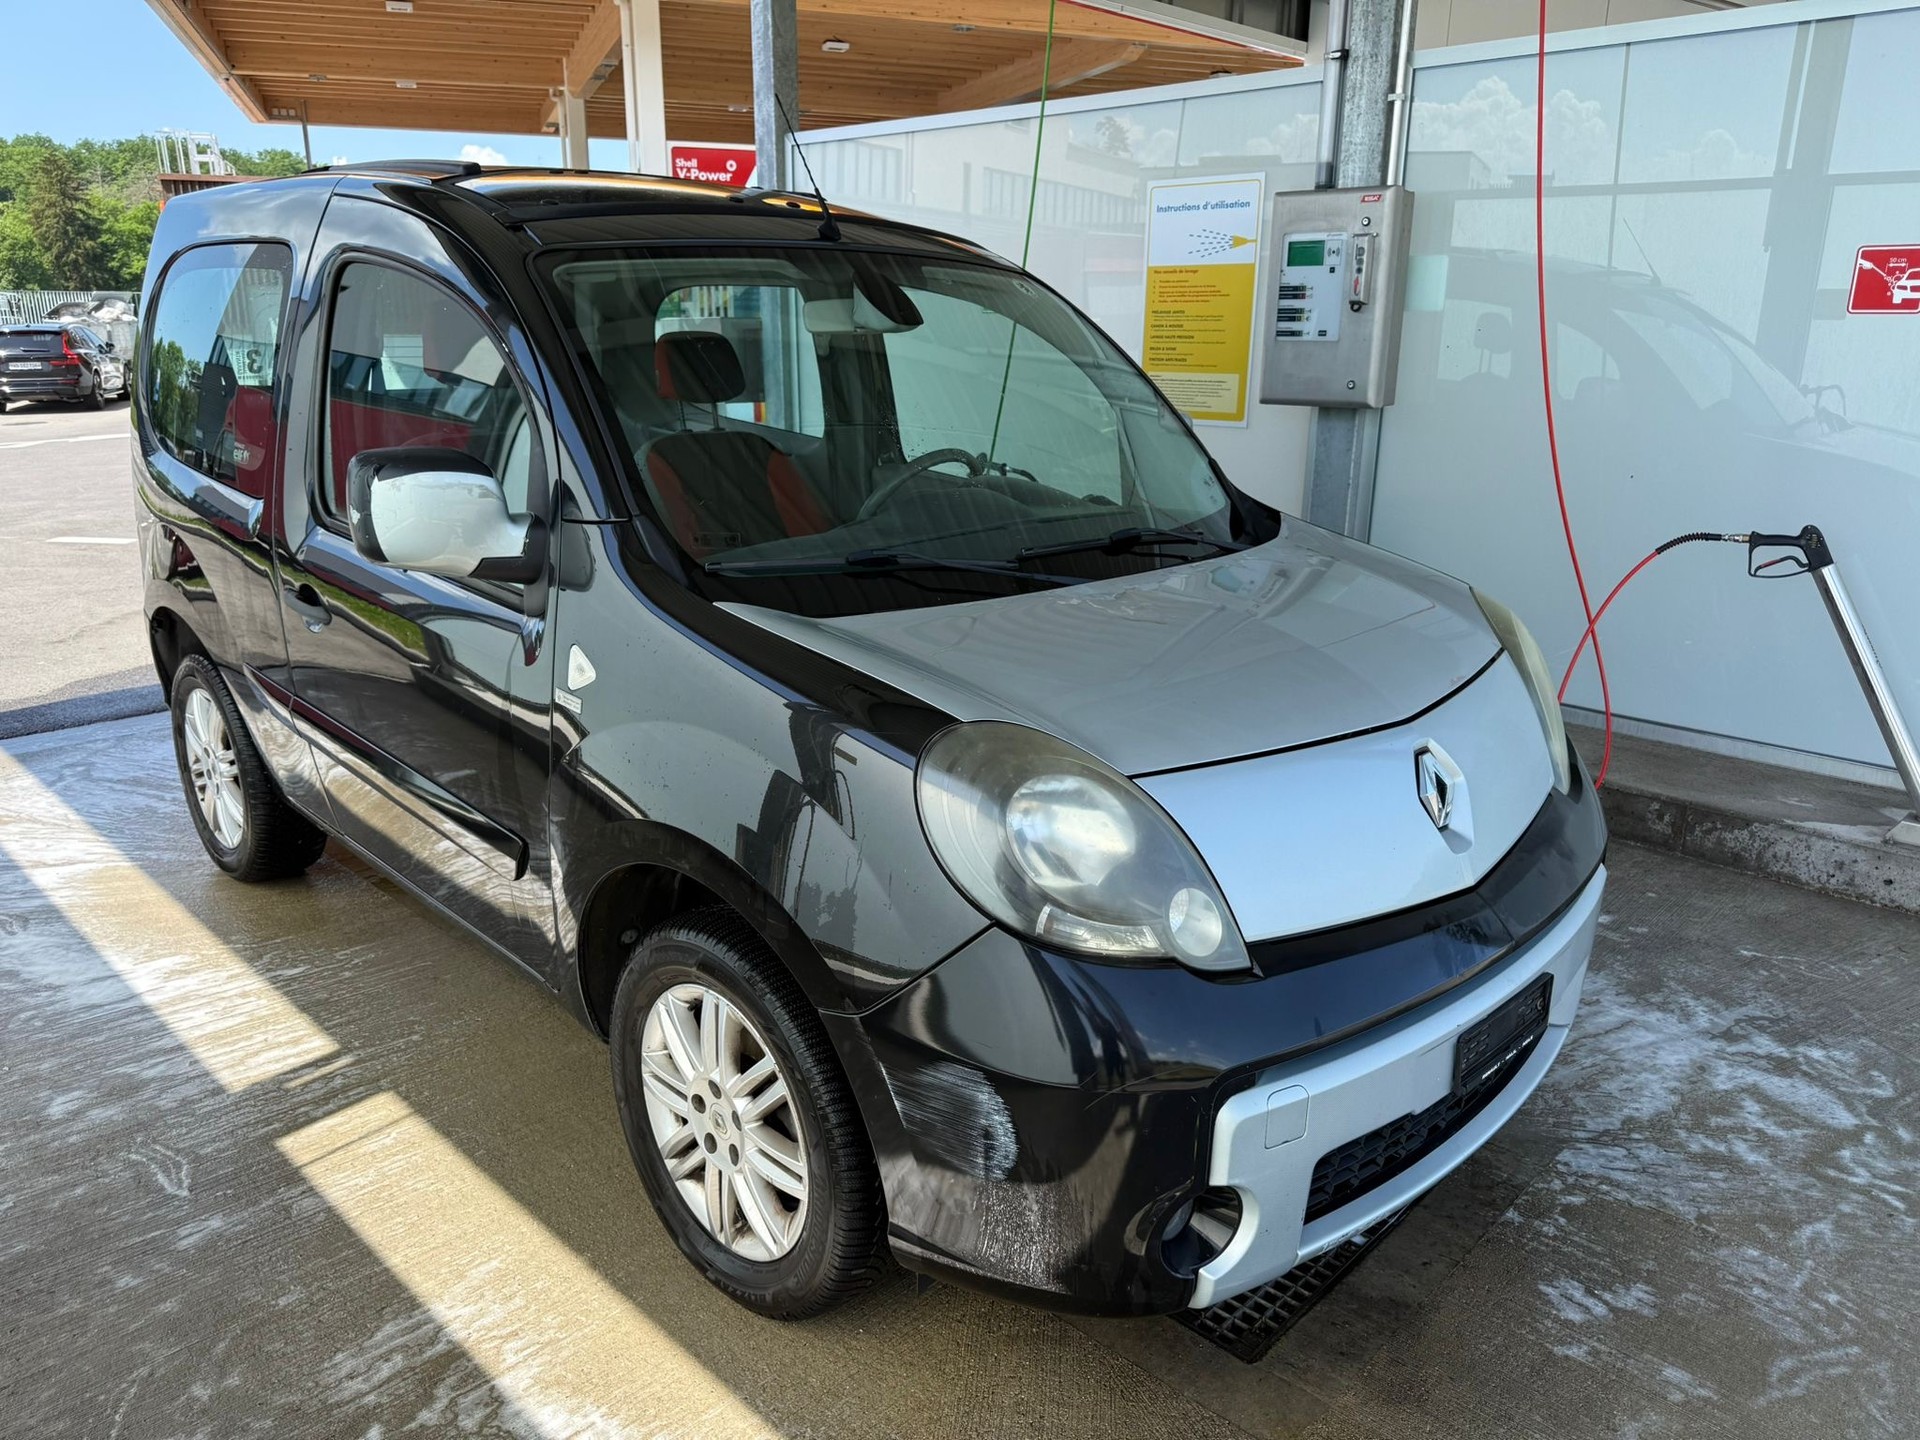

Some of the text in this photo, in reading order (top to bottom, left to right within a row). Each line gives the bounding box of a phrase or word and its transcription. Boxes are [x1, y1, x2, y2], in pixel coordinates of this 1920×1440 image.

[675, 158, 698, 168] Shell
[676, 168, 733, 182] V-Power
[1156, 200, 1251, 213] Instructions d'utilisation
